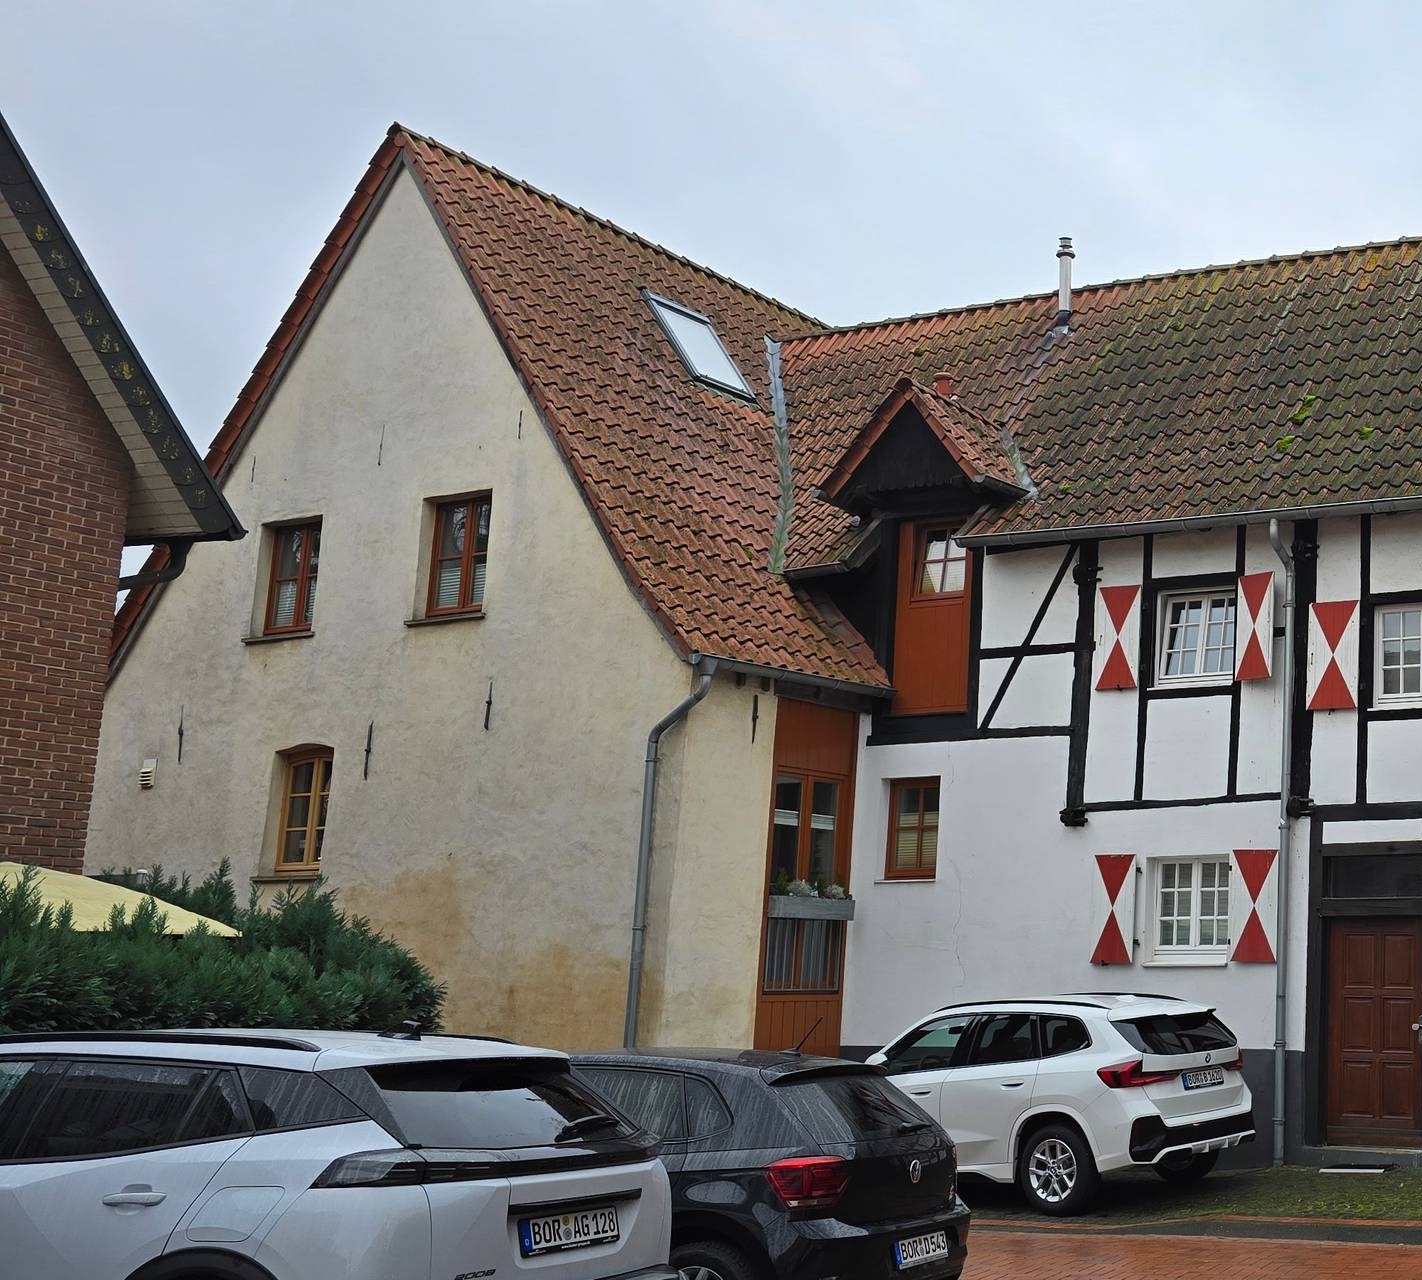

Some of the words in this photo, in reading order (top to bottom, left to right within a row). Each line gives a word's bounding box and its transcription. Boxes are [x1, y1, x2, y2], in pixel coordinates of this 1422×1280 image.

[1188, 1073, 1200, 1085] BOR
[531, 1219, 562, 1246] BOR
[573, 1214, 591, 1239] AG
[592, 1211, 616, 1236] 128
[900, 1239, 920, 1261] BOR
[923, 1237, 931, 1255] D
[930, 1233, 946, 1253] 543
